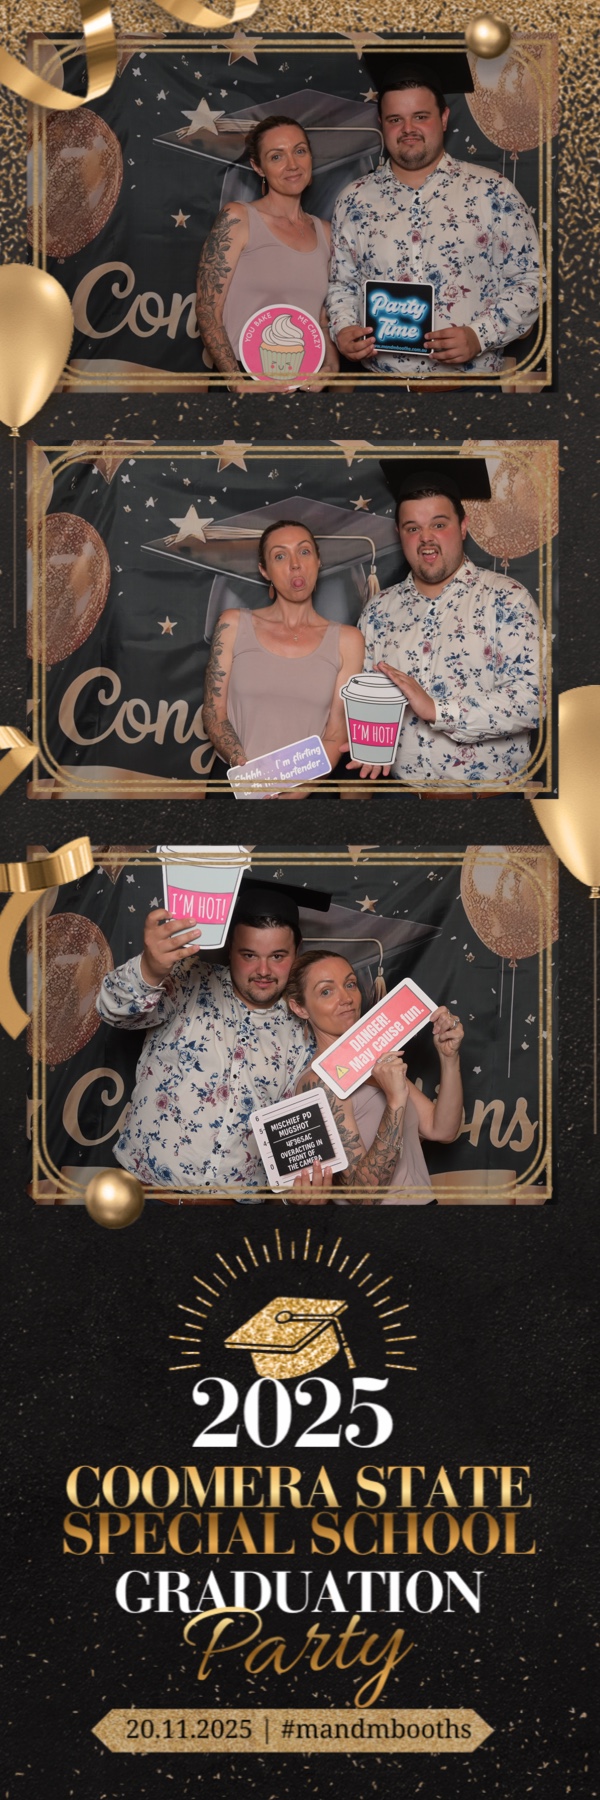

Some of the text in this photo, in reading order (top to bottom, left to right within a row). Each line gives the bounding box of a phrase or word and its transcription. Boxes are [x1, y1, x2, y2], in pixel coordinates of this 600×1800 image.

[371, 292, 427, 320] Party
[244, 312, 272, 343] YOU BAKE
[297, 315, 321, 349] ME CRAZY
[378, 318, 419, 340] Time
[352, 724, 394, 744] I'M HOT!
[275, 759, 291, 770] I'm
[293, 746, 321, 764] flirting
[280, 760, 325, 780] bartender.
[171, 893, 226, 921] I'M HOT!
[348, 1005, 425, 1072] May cause fun.
[349, 1012, 391, 1052] DANGER!
[270, 1111, 312, 1132] MISCHIEF PD
[278, 1121, 310, 1138] MUGSHOT
[280, 1138, 324, 1159] OVERACTING IN
[288, 1149, 316, 1164] FRONT OF
[287, 1162, 300, 1172] THE
